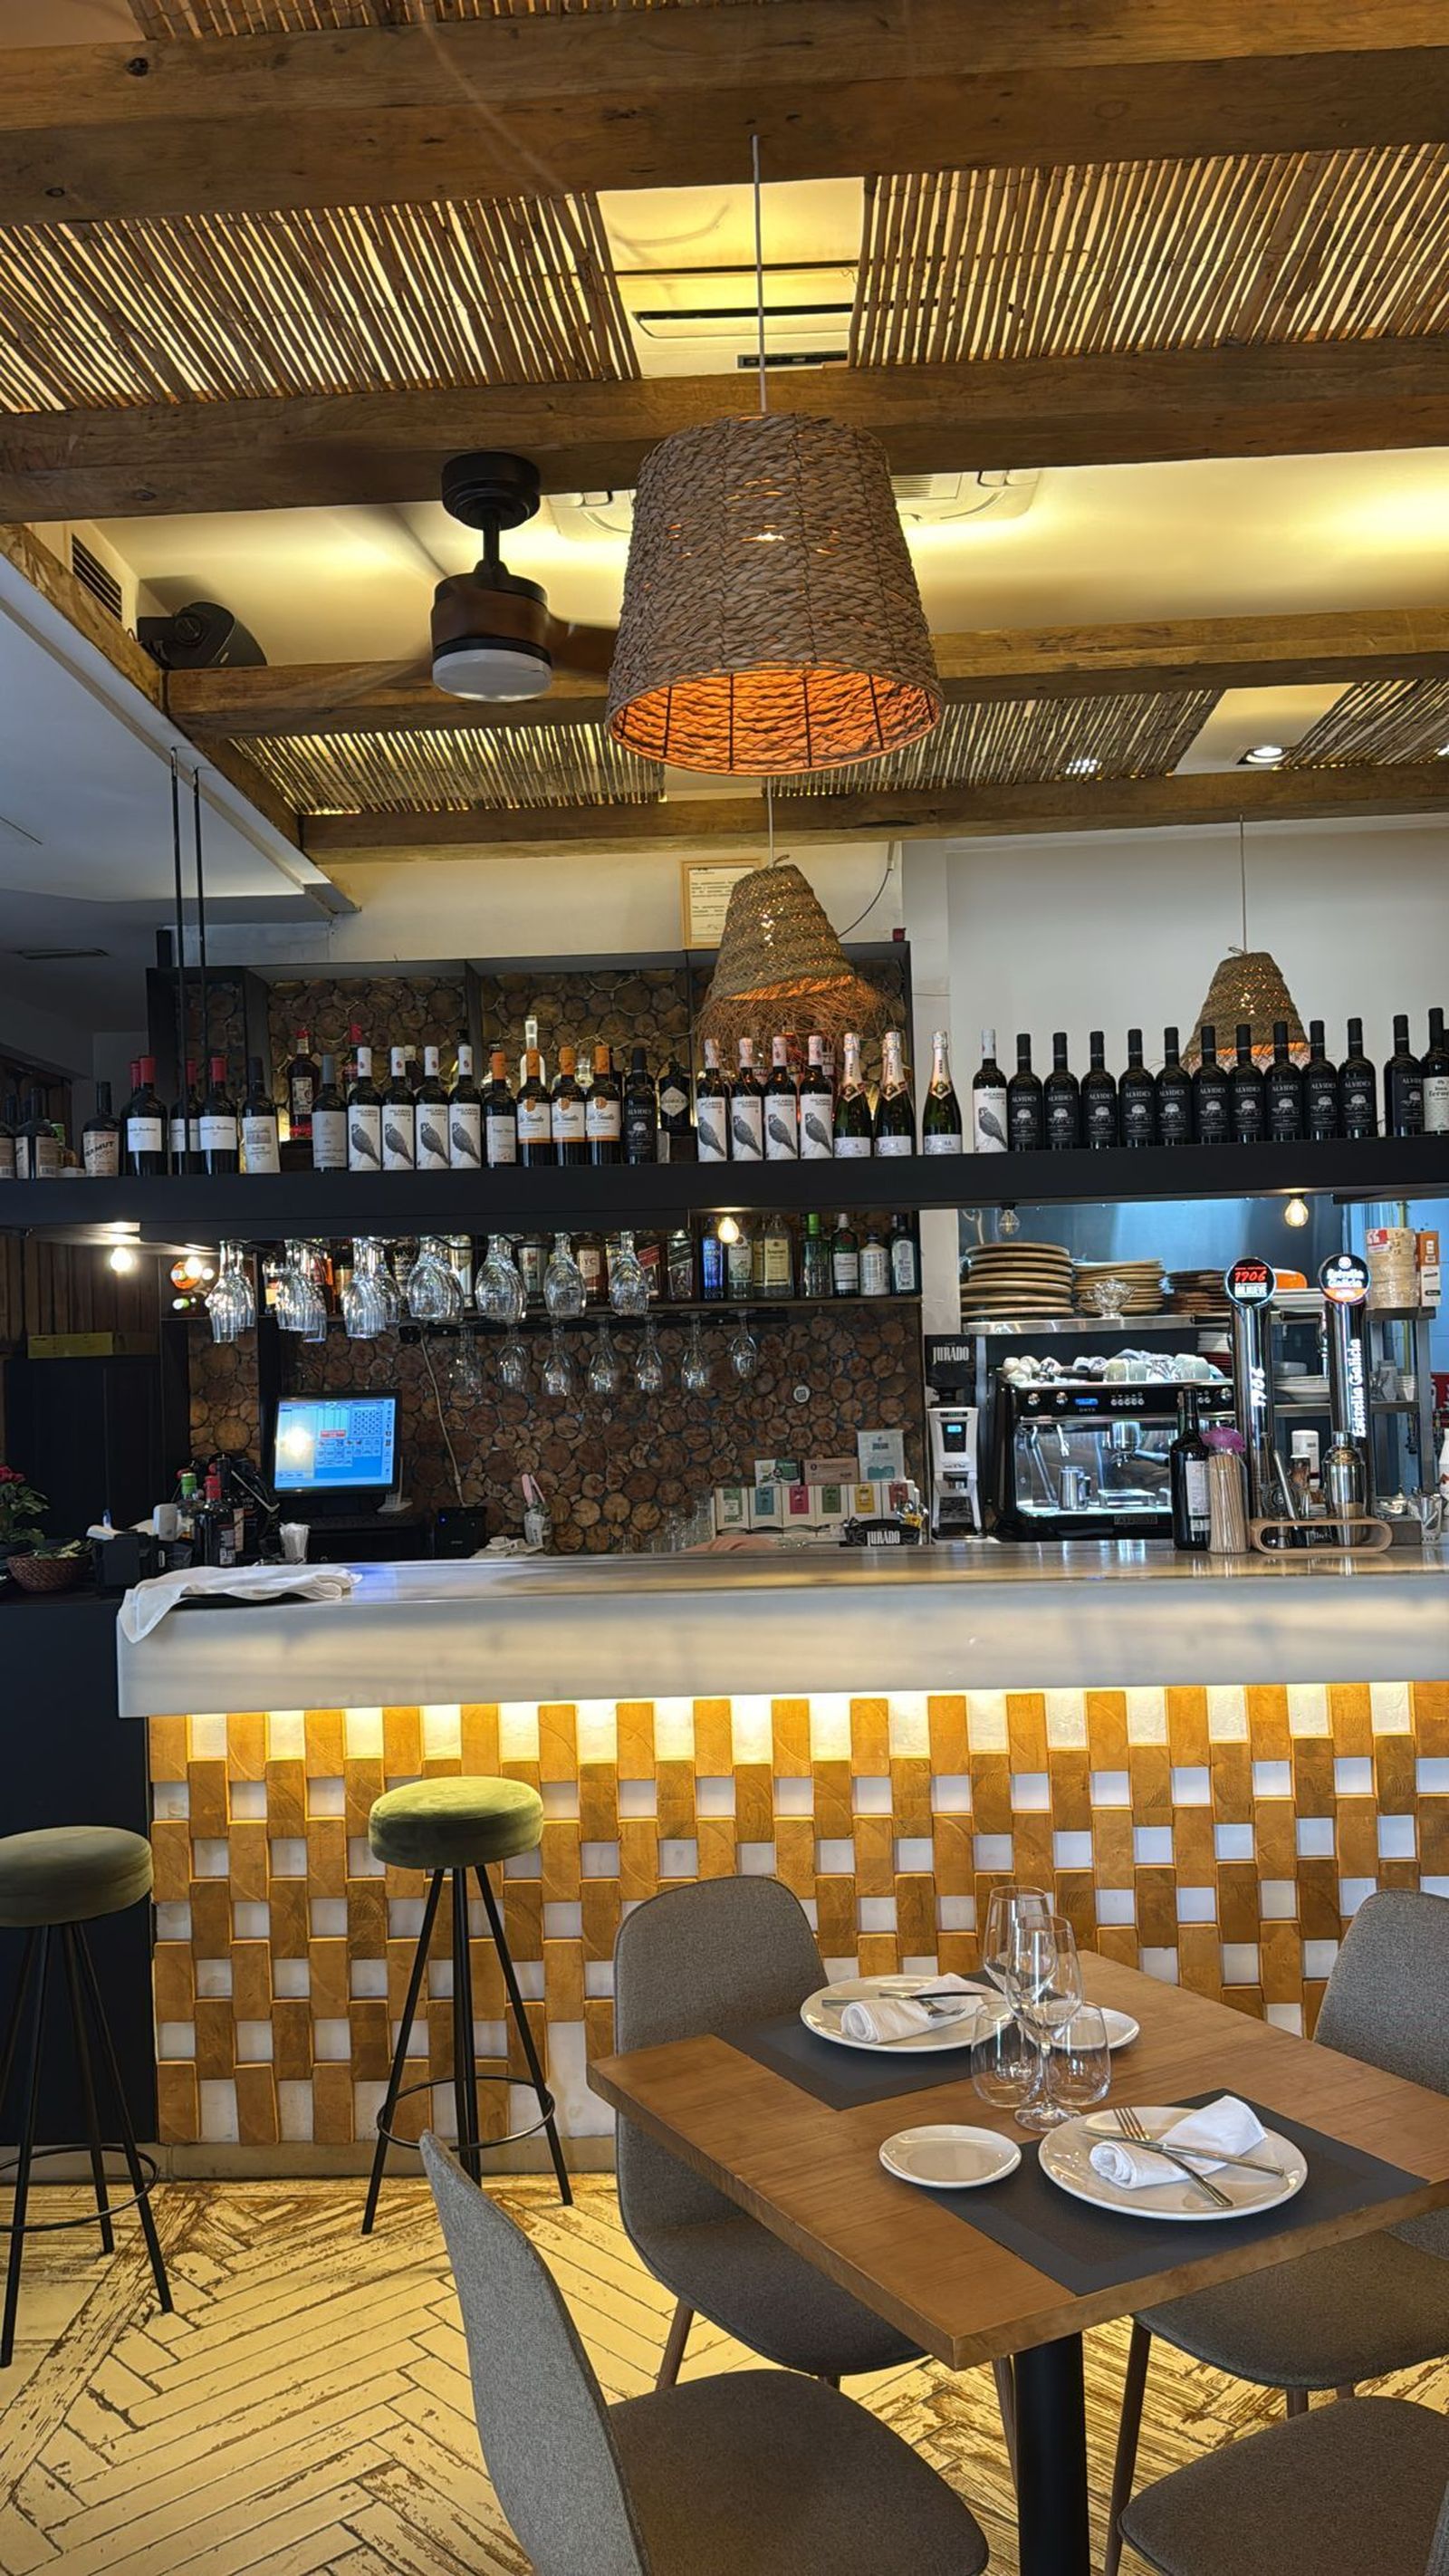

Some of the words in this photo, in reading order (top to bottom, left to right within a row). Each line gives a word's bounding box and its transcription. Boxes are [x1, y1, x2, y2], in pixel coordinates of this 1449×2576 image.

[1234, 1270, 1267, 1283] 1906
[932, 1346, 969, 1365] JURADO
[1348, 1339, 1363, 1385] Galicia
[1251, 1367, 1267, 1407] 1906
[1351, 1386, 1366, 1437] Estrella
[867, 1531, 900, 1546] JURADO
